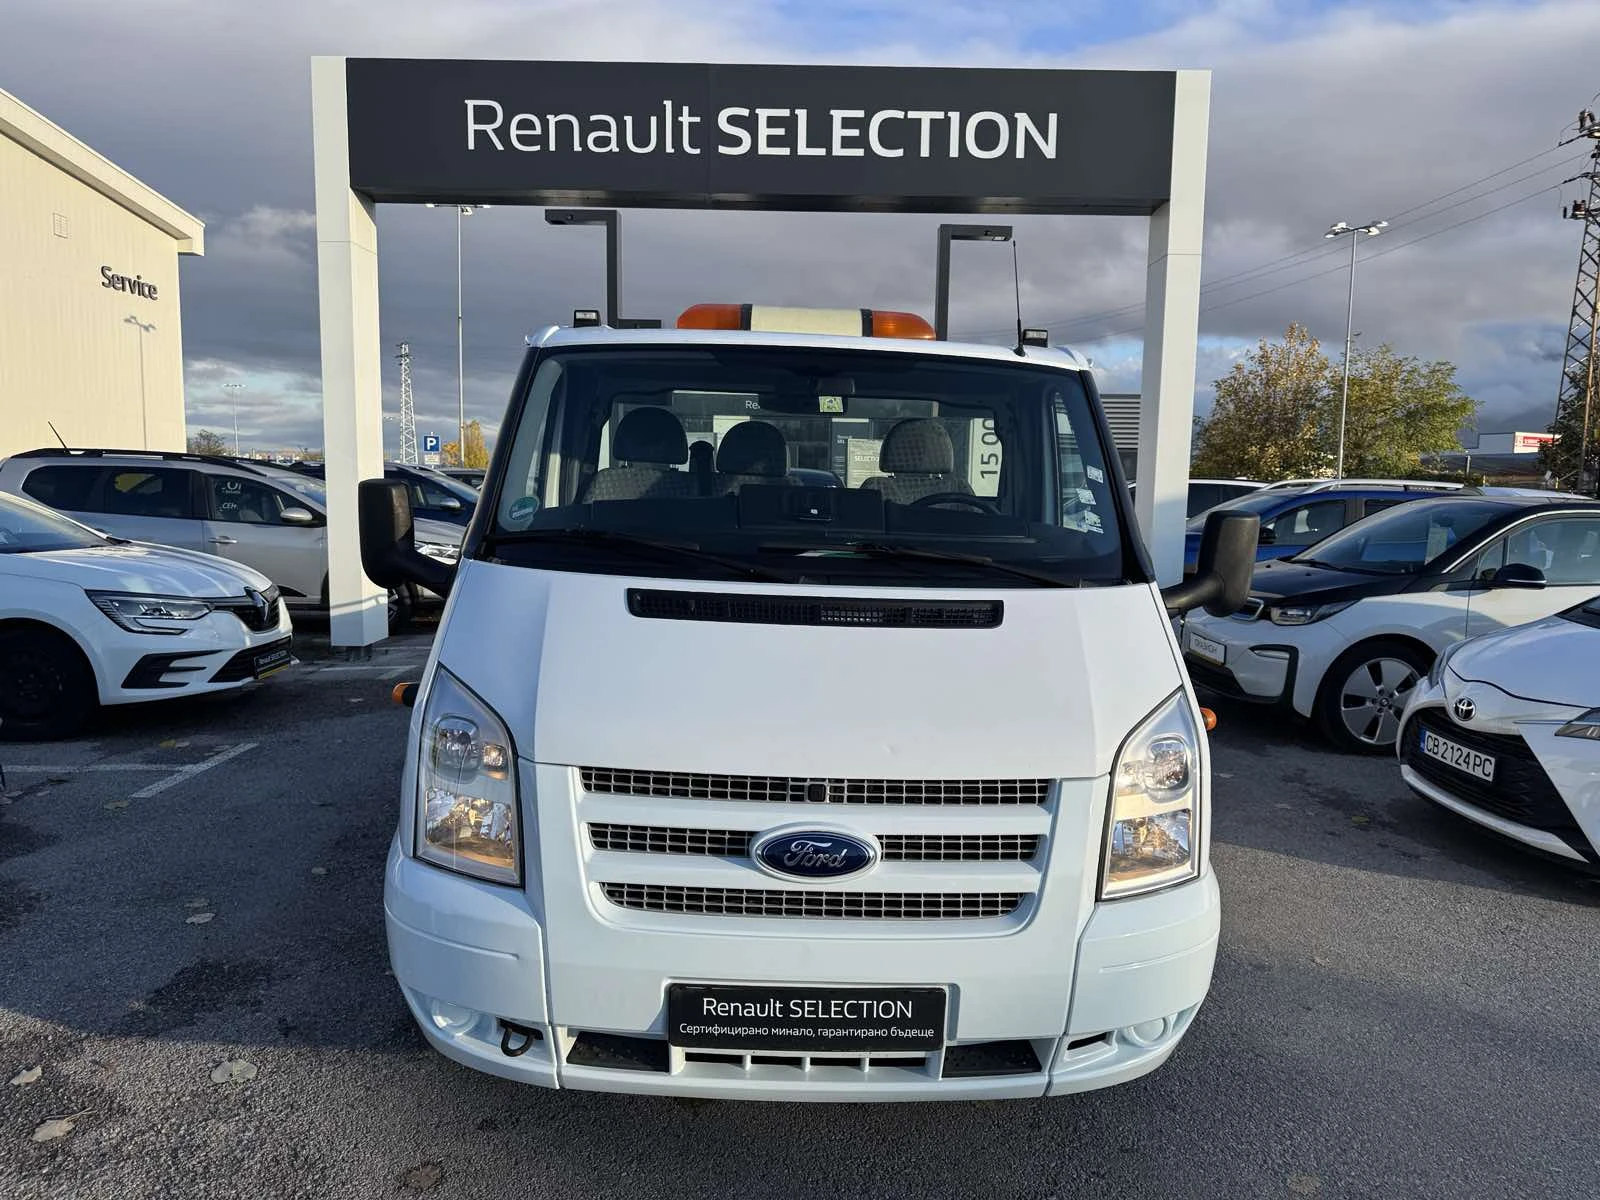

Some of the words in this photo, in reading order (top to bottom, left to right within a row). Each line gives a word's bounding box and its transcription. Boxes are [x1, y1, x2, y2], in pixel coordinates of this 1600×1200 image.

[464, 98, 702, 156] Renault
[716, 106, 1059, 160] SELECTION
[100, 265, 158, 301] Service
[426, 437, 437, 451] P
[783, 839, 848, 868] Ford
[703, 997, 784, 1018] Renault
[789, 999, 912, 1019] SELECTION
[679, 1022, 769, 1037] Сертифицирано
[771, 1026, 816, 1037] минало,
[817, 1028, 888, 1039] гарантирано
[890, 1026, 935, 1039] бъдеще
